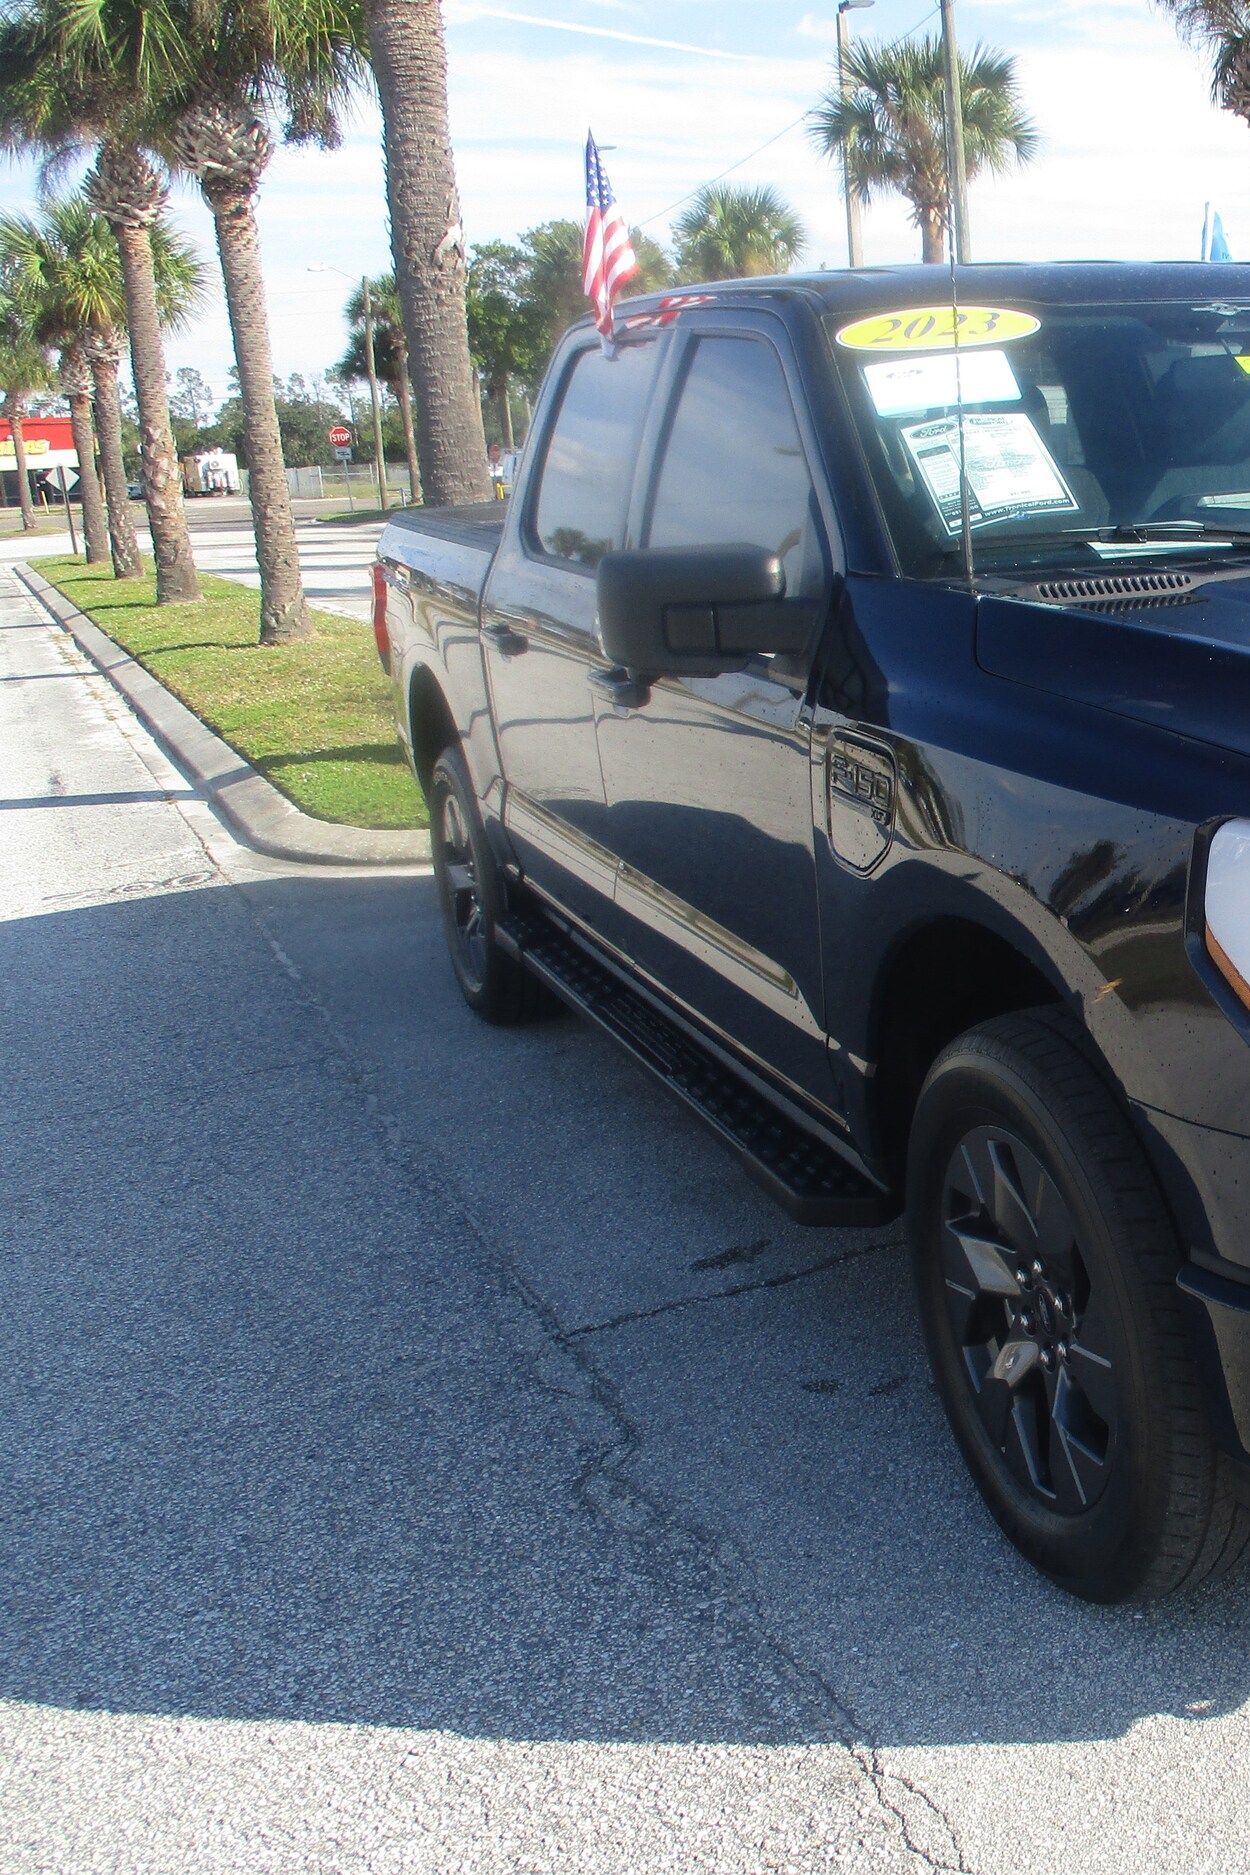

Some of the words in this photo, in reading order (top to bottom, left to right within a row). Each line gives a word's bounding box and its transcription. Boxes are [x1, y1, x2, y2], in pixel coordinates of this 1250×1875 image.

[869, 312, 1002, 344] 2023
[331, 433, 350, 442] STOP
[920, 425, 947, 437] Ford
[831, 754, 892, 808] F-150
